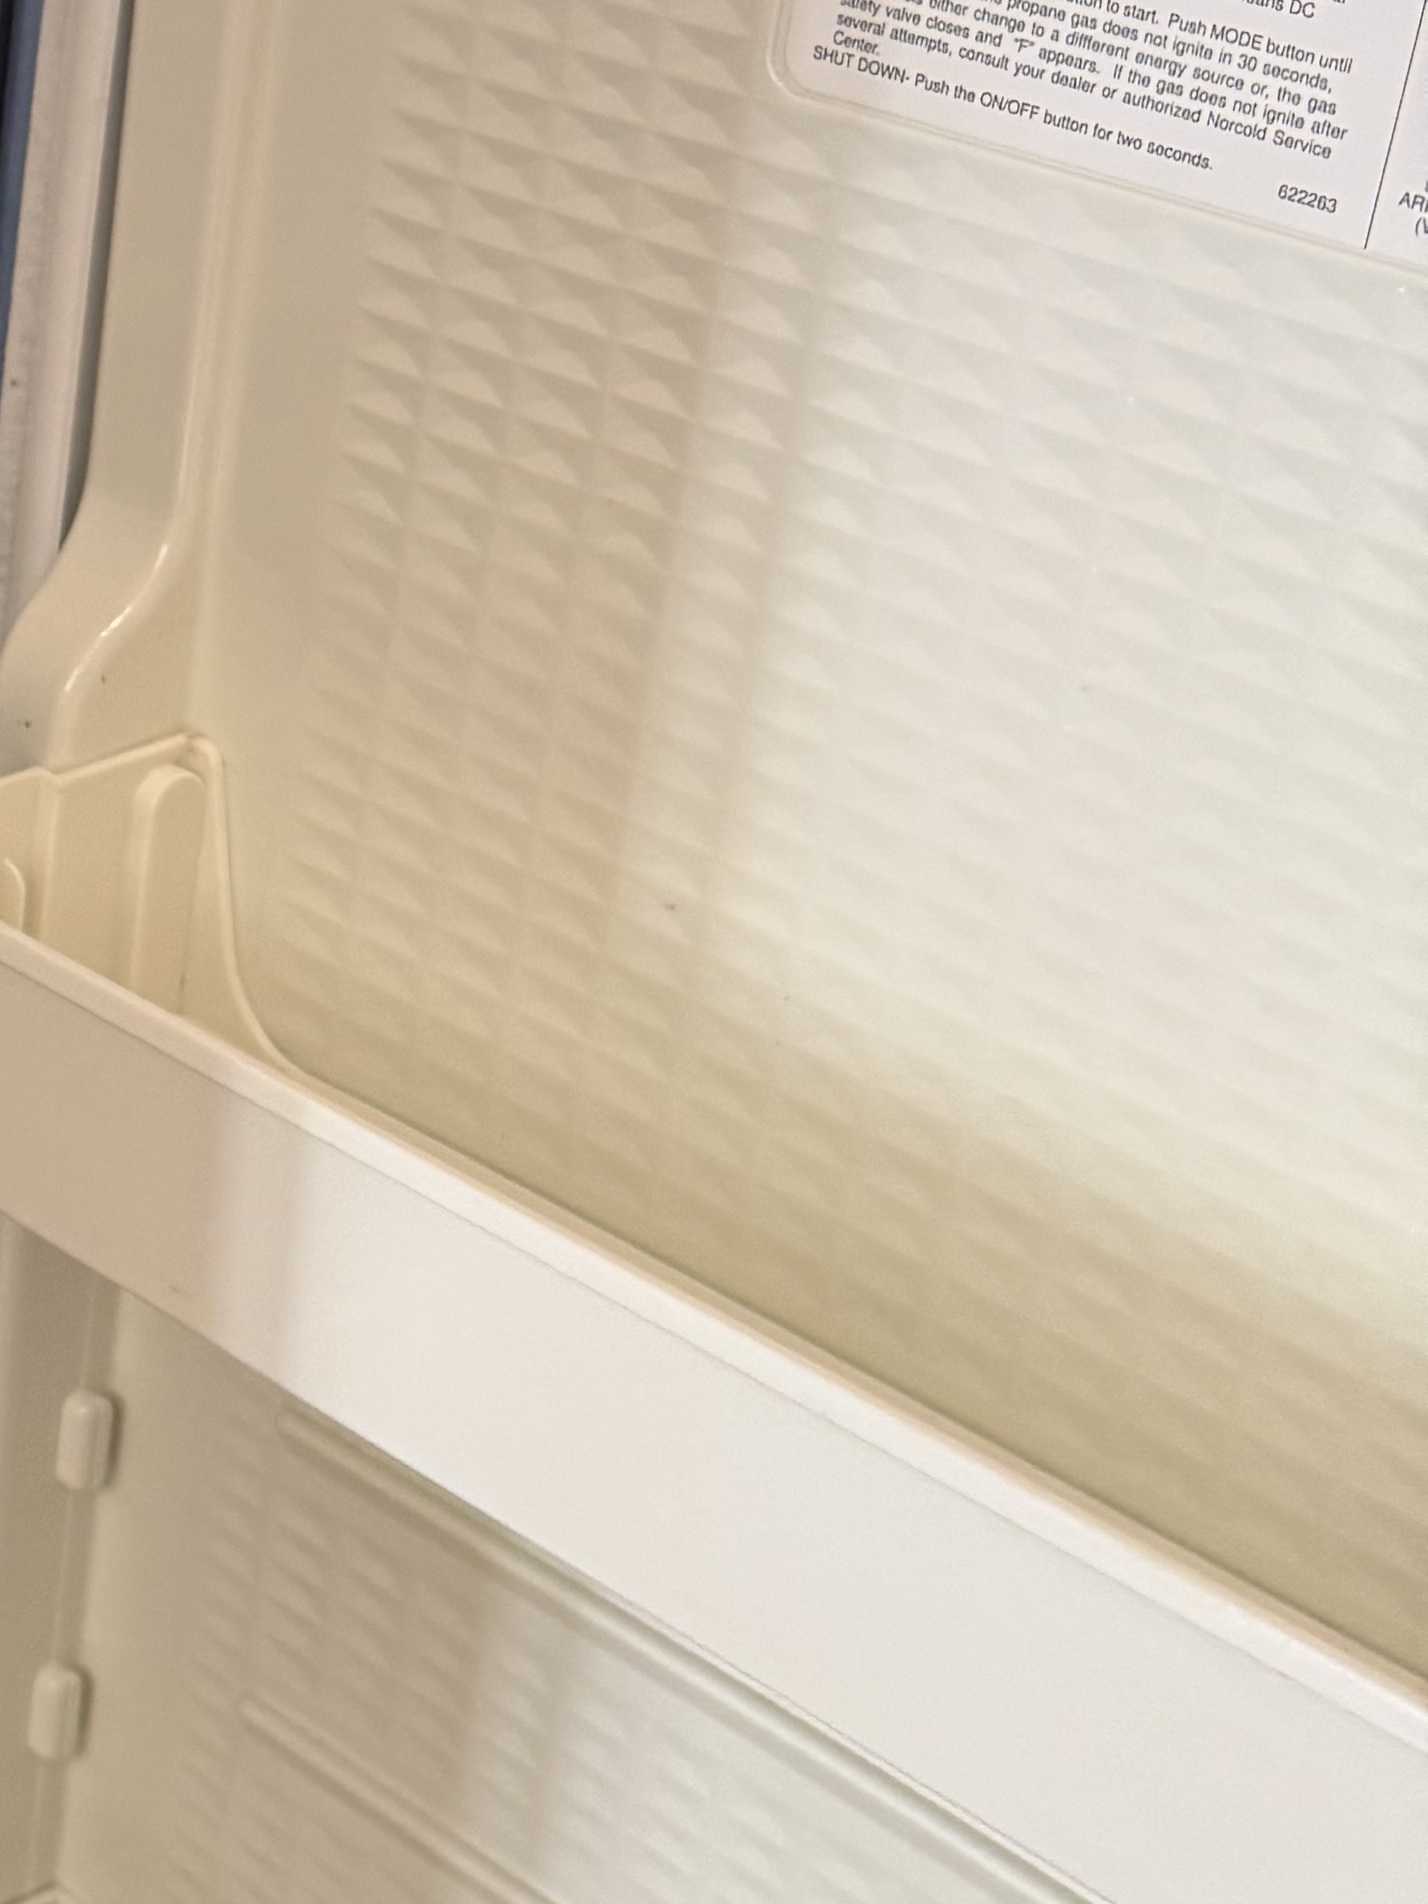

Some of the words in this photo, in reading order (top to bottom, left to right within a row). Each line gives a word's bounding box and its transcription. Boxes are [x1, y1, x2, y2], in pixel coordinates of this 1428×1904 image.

[833, 30, 879, 56] Center.
[836, 14, 886, 36] several
[889, 28, 952, 57] attempts,
[958, 46, 1010, 71] consult
[1013, 62, 1046, 80] your
[1051, 70, 1097, 94] dealer
[1101, 86, 1118, 99] or
[1122, 91, 1202, 123] authorized
[1207, 110, 1268, 141] Norcold
[1272, 129, 1332, 159] Service
[886, 6, 921, 26] valve
[925, 16, 970, 39] closes
[975, 30, 1003, 48] and
[1038, 47, 1100, 74] appears.
[1113, 63, 1124, 80] If
[1127, 68, 1151, 88] the
[1156, 79, 1184, 97] gas
[1189, 86, 1227, 109] does
[1232, 99, 1258, 117] not
[1262, 103, 1305, 129] ignite
[1310, 119, 1348, 140] after
[973, 7, 1026, 34] change
[1031, 21, 1045, 38] to
[1050, 29, 1060, 42] a
[1135, 52, 1188, 78] energy
[1192, 67, 1245, 91] source
[1250, 82, 1269, 100] or,
[1277, 86, 1302, 106] the
[1307, 97, 1337, 115] gas
[1071, 13, 1098, 30] gas
[1102, 19, 1139, 41] does
[1143, 32, 1168, 49] not
[1172, 35, 1213, 61] ignite
[1218, 48, 1233, 65] in
[1237, 53, 1258, 72] 30
[1262, 63, 1332, 94] seconds,
[1123, 5, 1159, 25] start.
[1167, 12, 1207, 37] Push
[1210, 23, 1264, 51] MODE
[1266, 37, 1315, 65] button
[1319, 54, 1353, 74] until
[813, 45, 852, 68] SHUT
[914, 72, 950, 96] Push
[954, 85, 976, 103] the
[980, 91, 1040, 120] ON/OFF
[1043, 109, 1088, 135] button
[1092, 123, 1114, 141] for
[1116, 130, 1143, 150] two
[1146, 141, 1213, 170] seconds.
